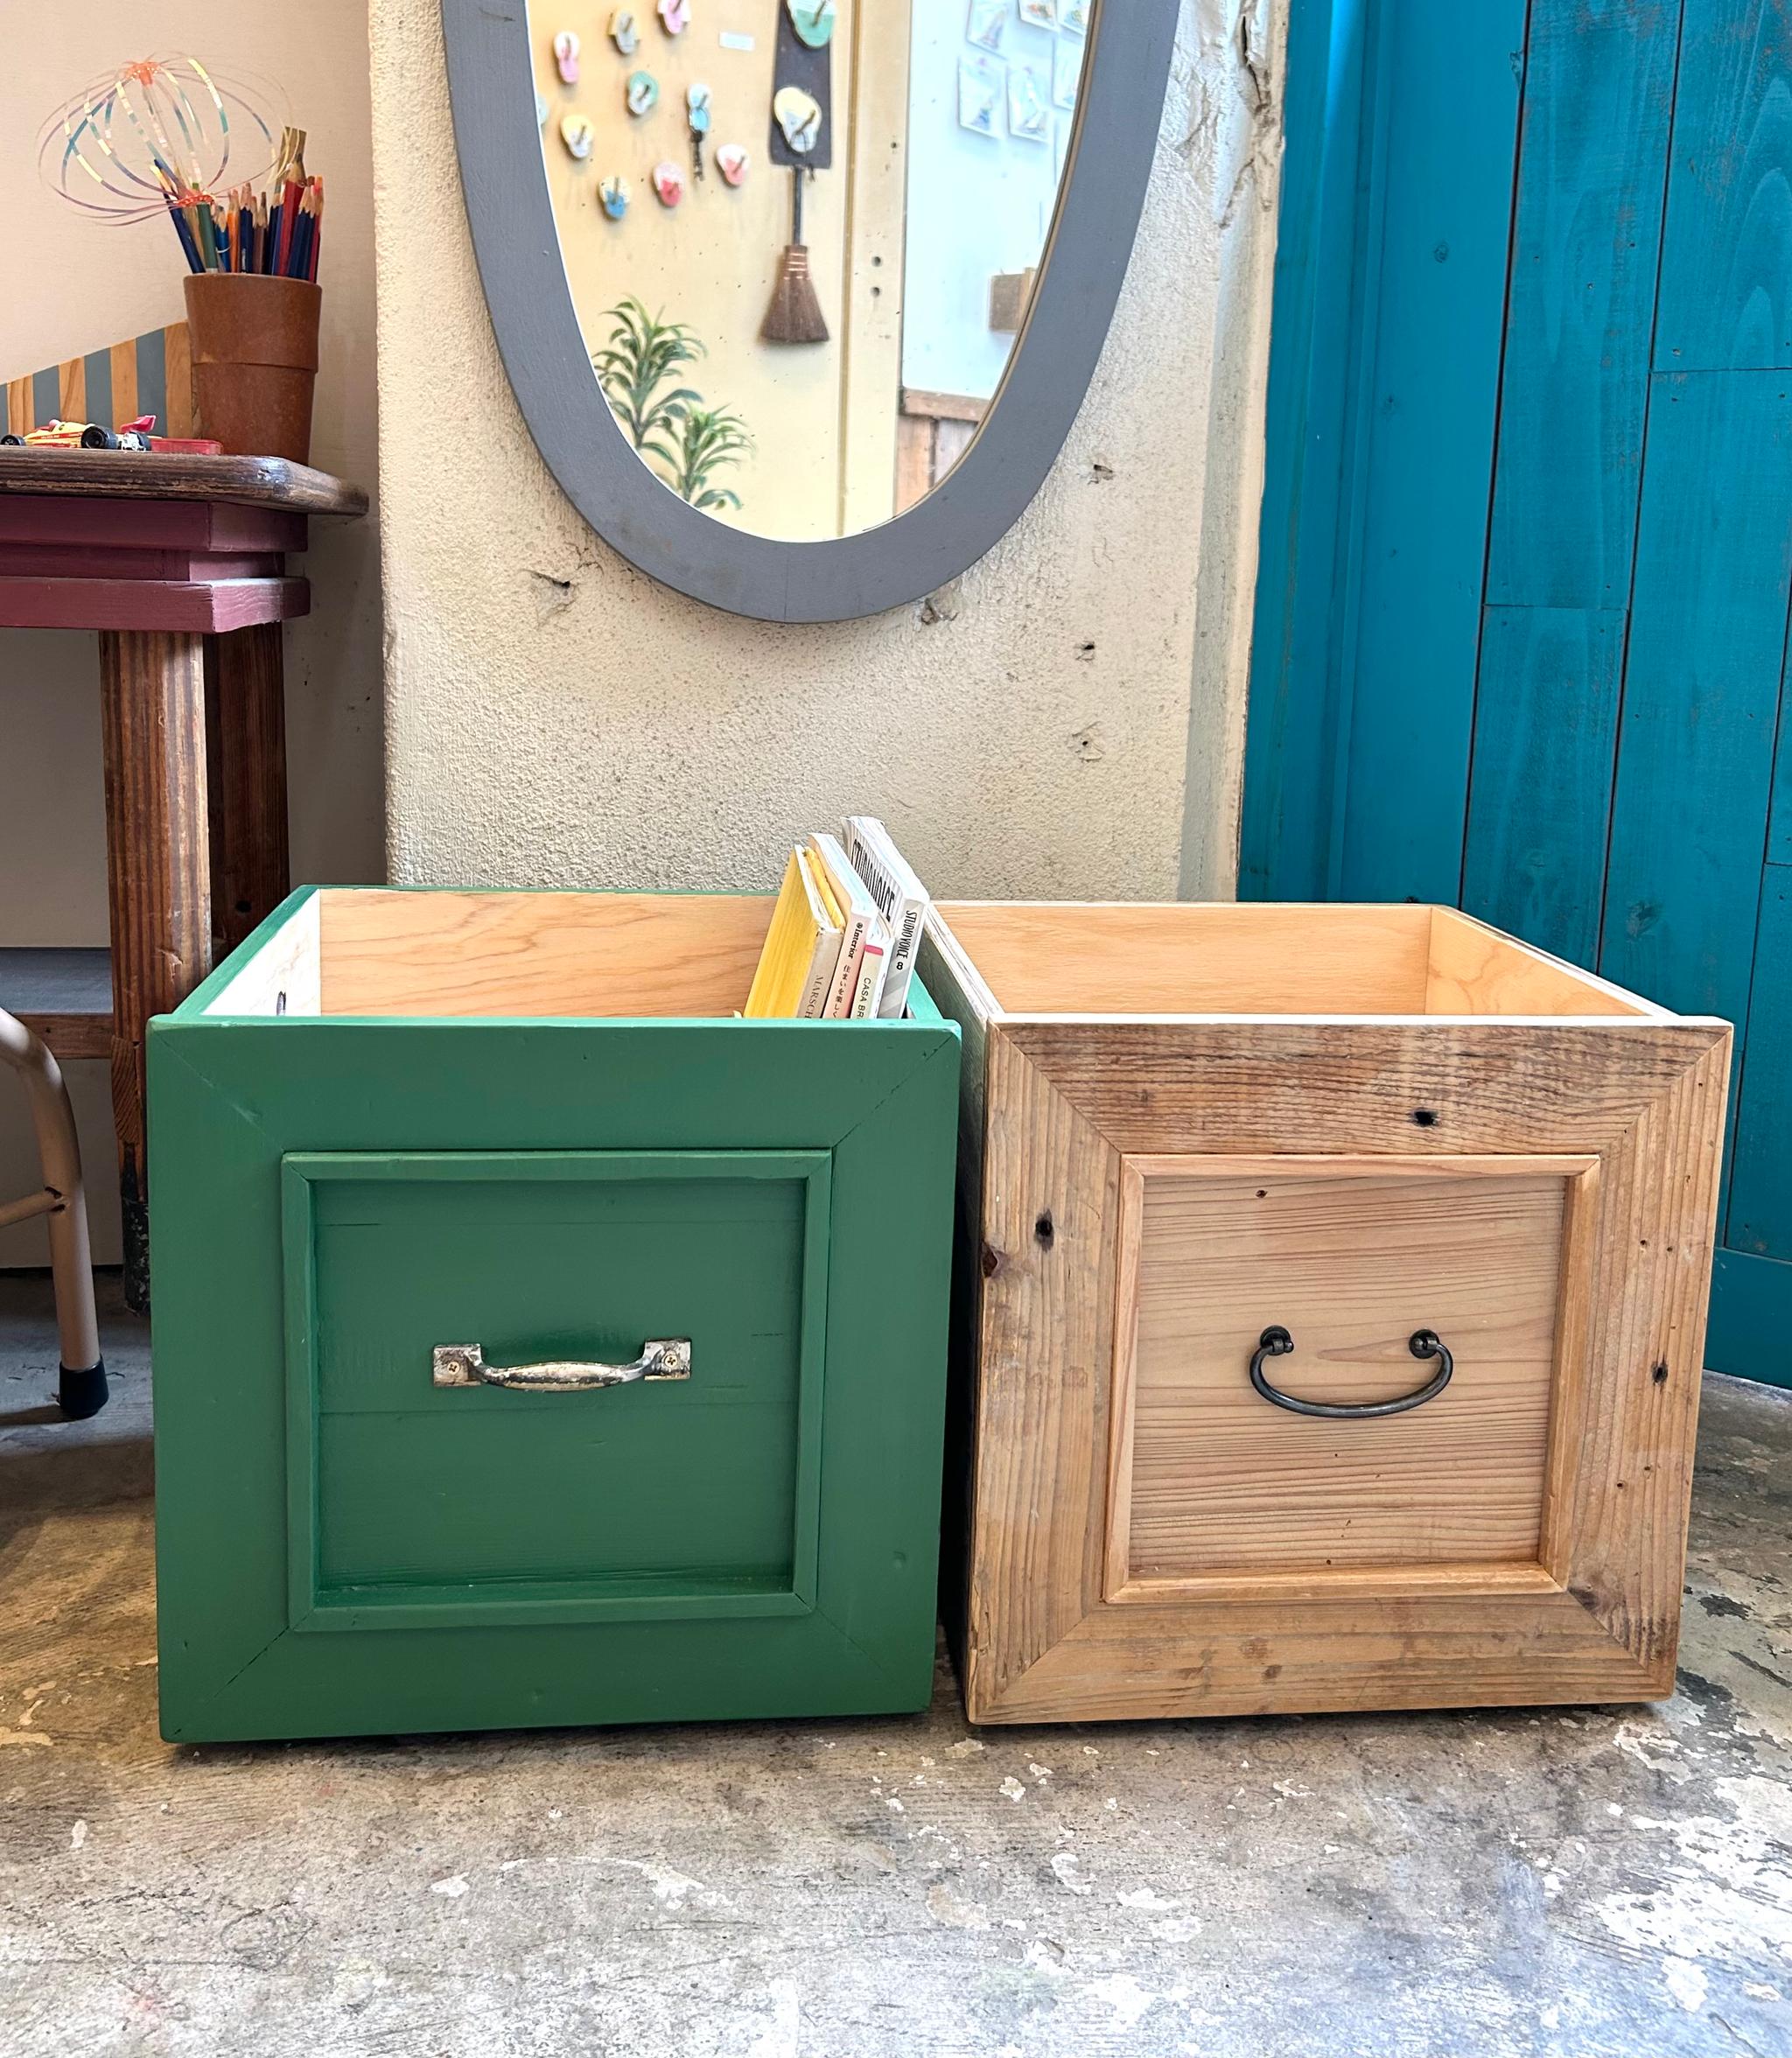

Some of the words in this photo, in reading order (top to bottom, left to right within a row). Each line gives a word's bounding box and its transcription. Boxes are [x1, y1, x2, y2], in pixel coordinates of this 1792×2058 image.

[848, 928, 863, 959] Interior
[896, 962, 904, 970] 8
[860, 977, 872, 1002] CASA
[857, 1004, 865, 1018] BR
